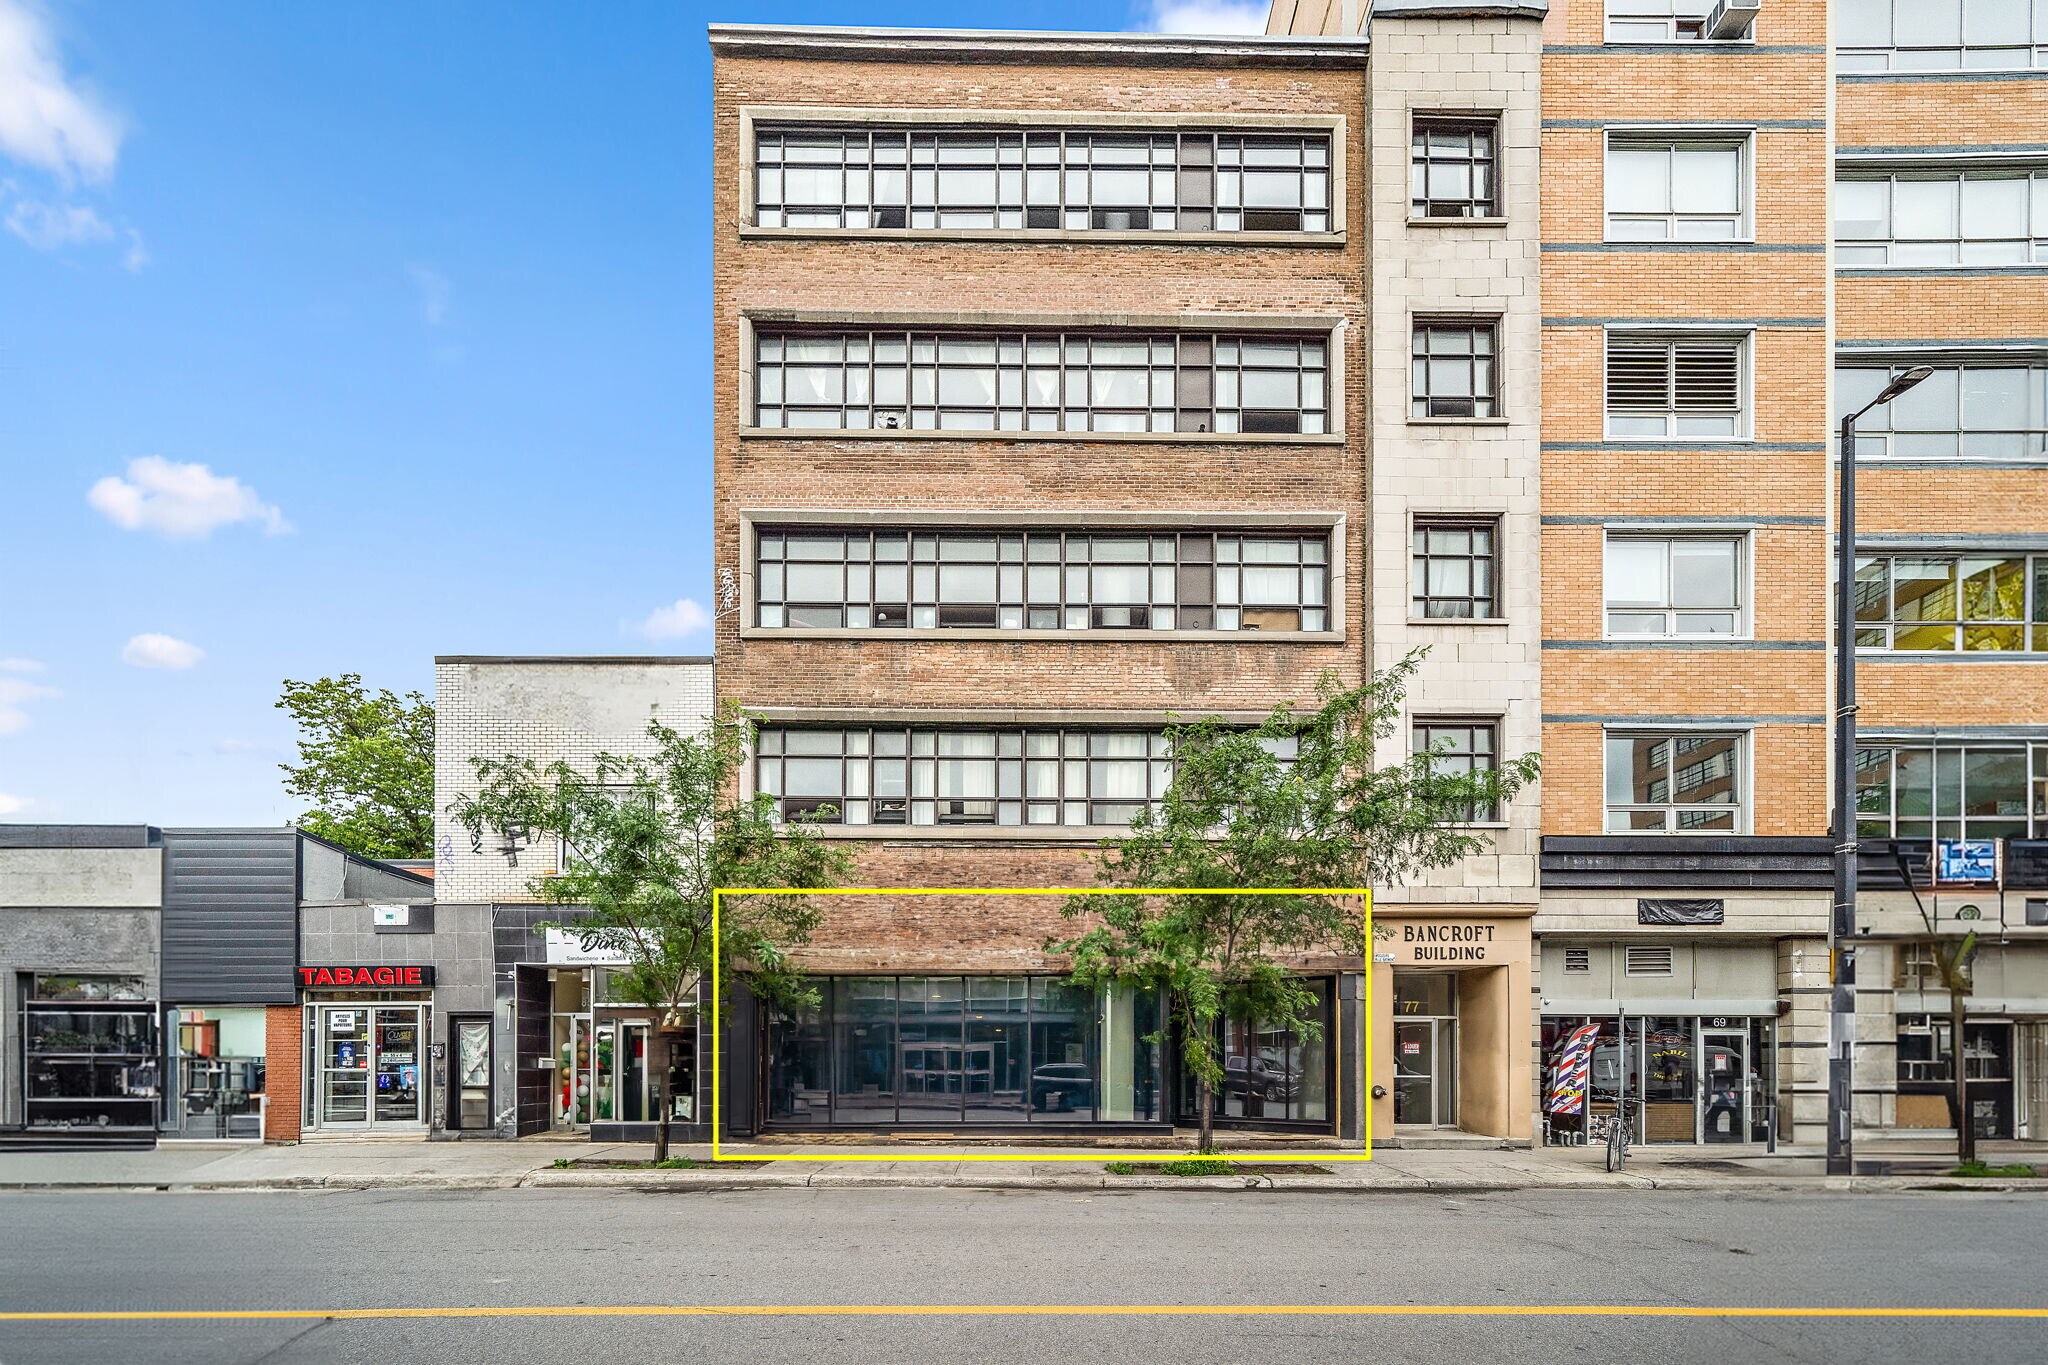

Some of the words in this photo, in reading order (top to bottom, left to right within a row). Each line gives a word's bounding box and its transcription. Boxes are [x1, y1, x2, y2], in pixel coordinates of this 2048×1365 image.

[1404, 925, 1495, 941] BANCROFT
[1414, 946, 1485, 960] BUILDING
[299, 968, 422, 985] TABAGIE
[1404, 1001, 1419, 1013] 77
[1713, 1017, 1726, 1027] 69
[1565, 1033, 1592, 1088] BARBER
[1558, 1089, 1583, 1097] SHOP
